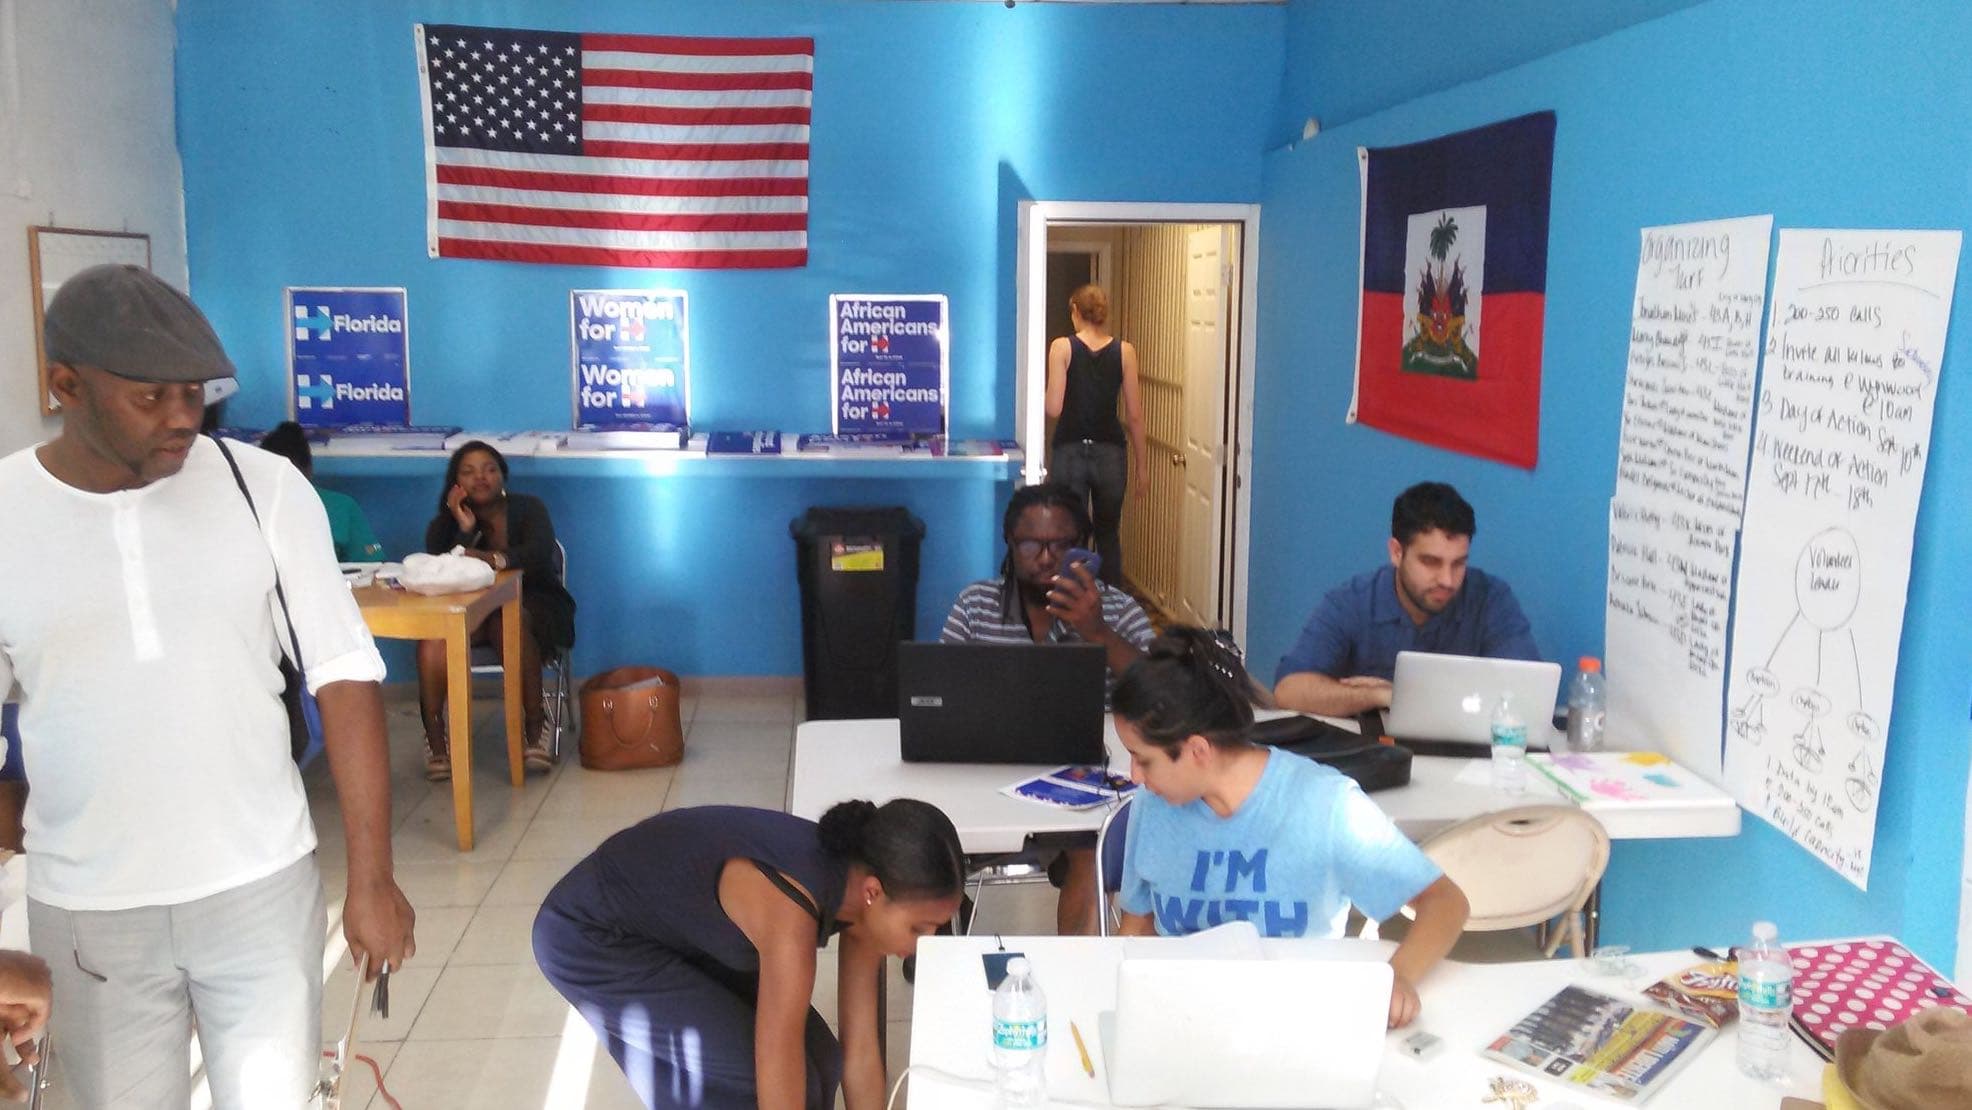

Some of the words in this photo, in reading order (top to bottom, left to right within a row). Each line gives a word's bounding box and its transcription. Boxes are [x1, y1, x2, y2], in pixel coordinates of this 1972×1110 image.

[579, 295, 674, 320] Women
[840, 301, 906, 319] African
[333, 314, 402, 333] Florida
[579, 318, 616, 341] for
[840, 318, 938, 336] Americans
[841, 335, 868, 353] for
[581, 364, 675, 387] Women
[841, 367, 907, 386] African
[336, 382, 404, 401] Florida
[581, 385, 617, 408] for
[841, 385, 939, 402] Americans
[841, 401, 869, 420] for
[1780, 397, 1807, 432] Day
[1191, 849, 1268, 893] I'M
[1153, 890, 1308, 938] WITH
